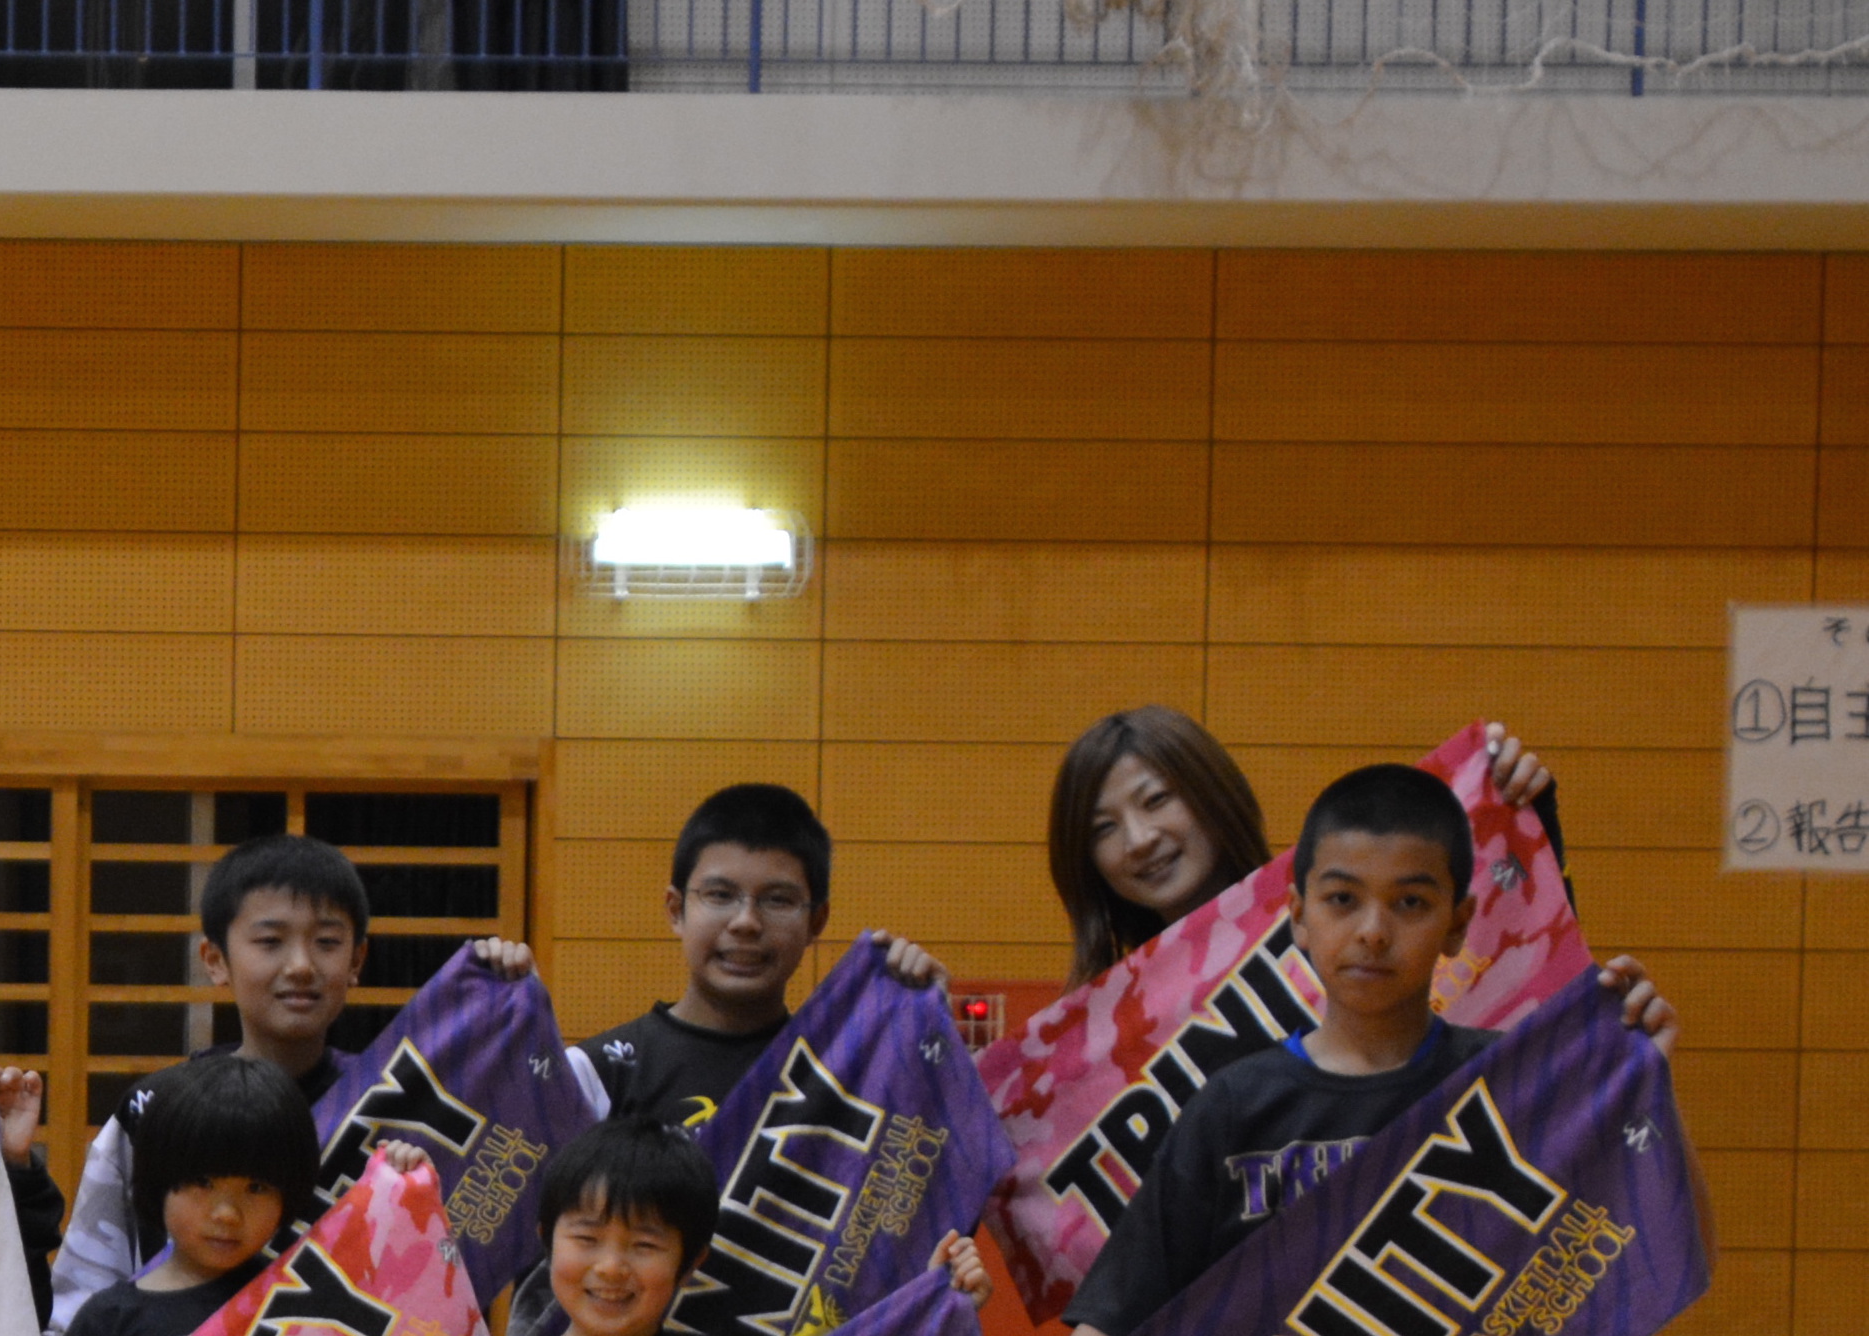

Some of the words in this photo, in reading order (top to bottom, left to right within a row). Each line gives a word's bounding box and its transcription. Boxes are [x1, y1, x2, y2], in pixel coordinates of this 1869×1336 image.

[465, 1139, 549, 1245] SCHOOL
[824, 1112, 924, 1290] BASKETBALL
[879, 1124, 949, 1238] SCHOOL
[1530, 1217, 1637, 1336] SCHOOL
